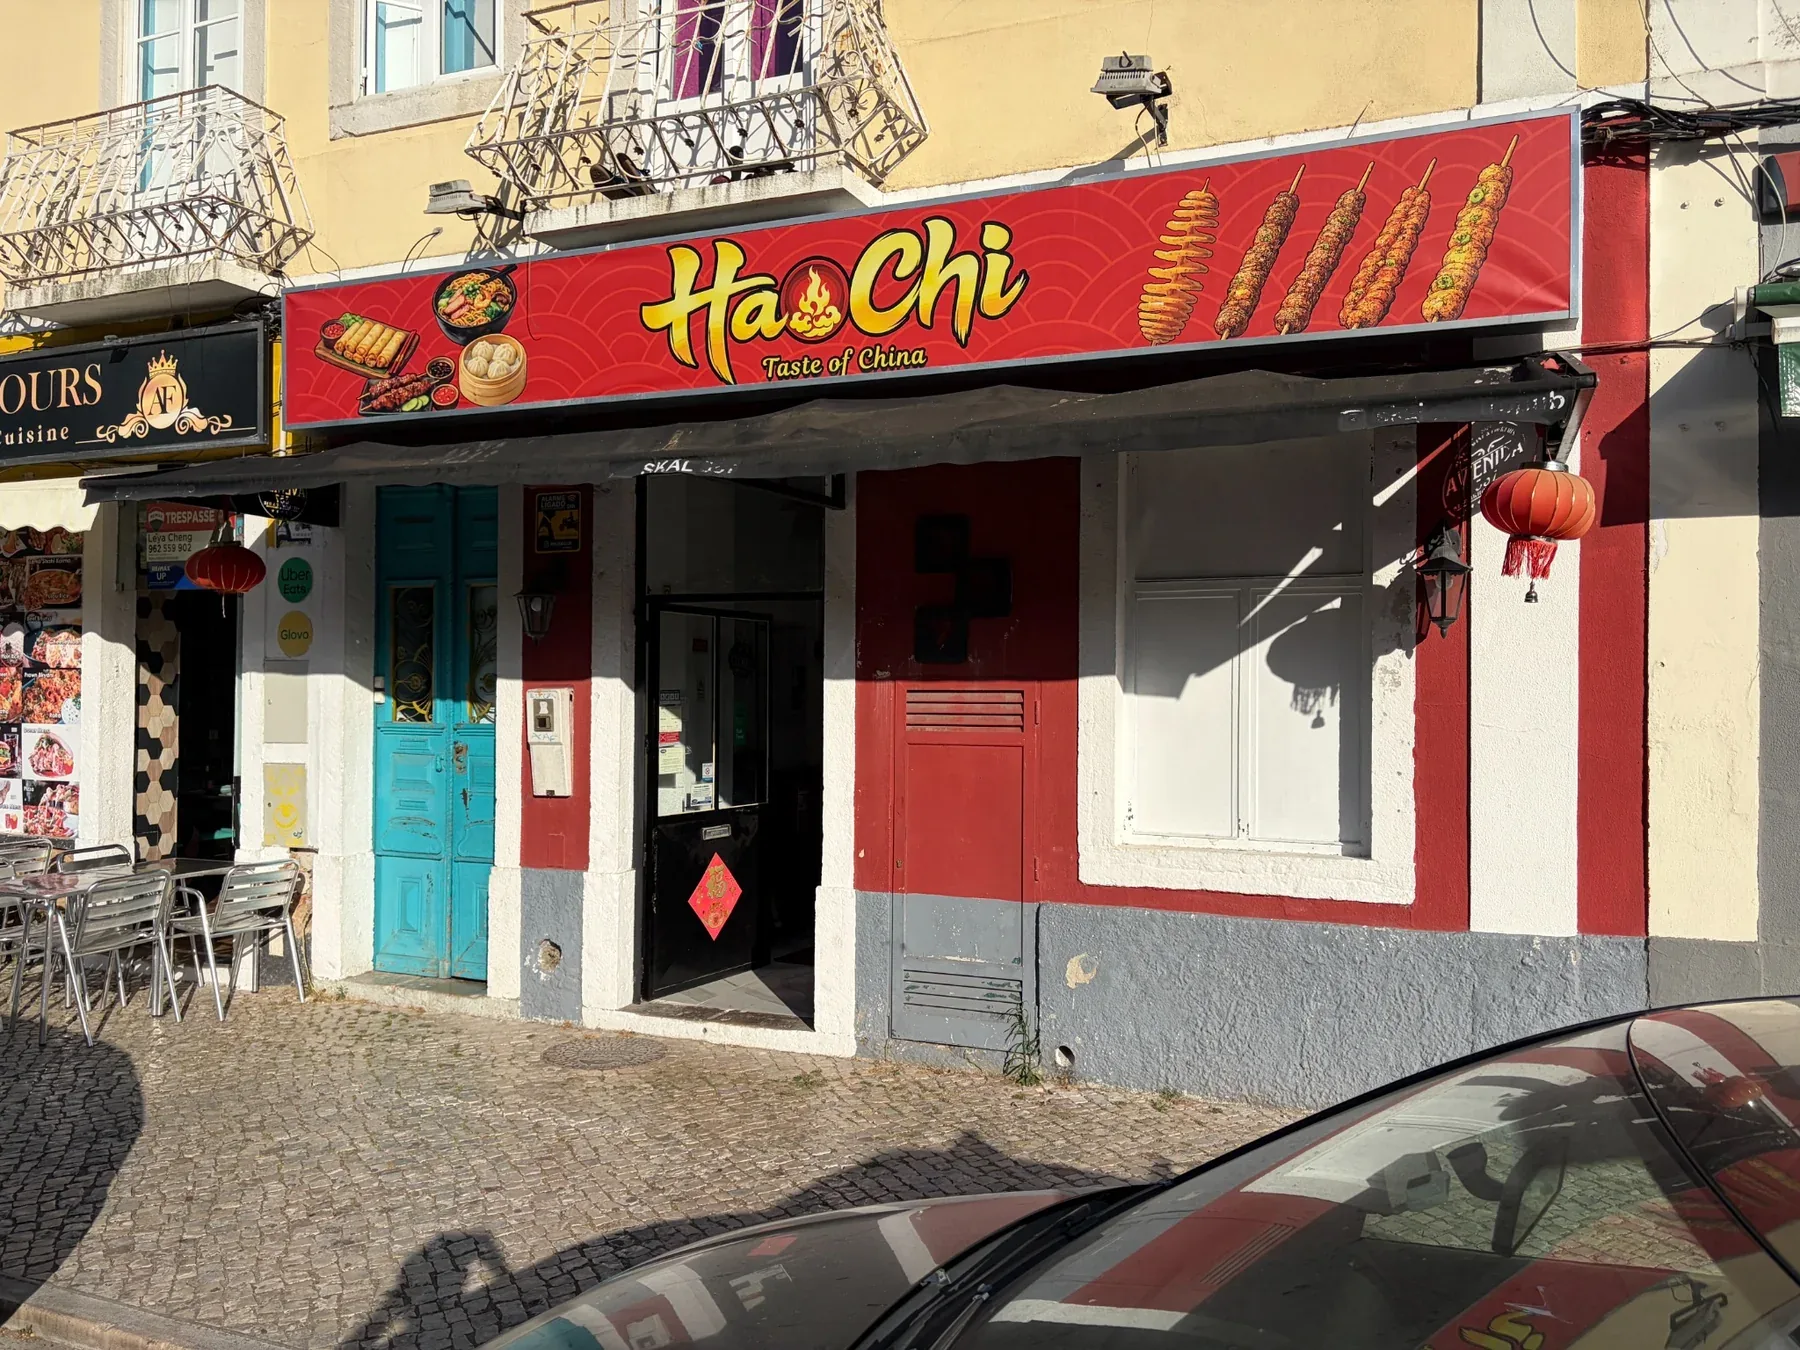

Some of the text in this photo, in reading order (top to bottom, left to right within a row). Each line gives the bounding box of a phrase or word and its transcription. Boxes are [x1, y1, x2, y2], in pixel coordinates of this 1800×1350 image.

[762, 344, 927, 381] Taste of China
[165, 509, 215, 524] TRESPASSE
[168, 533, 193, 542] Cheng
[148, 543, 192, 553] 962 559 902
[156, 572, 167, 581] UP
[281, 568, 310, 581] Uber
[283, 583, 307, 595] Eats
[280, 629, 309, 640] Glovo
